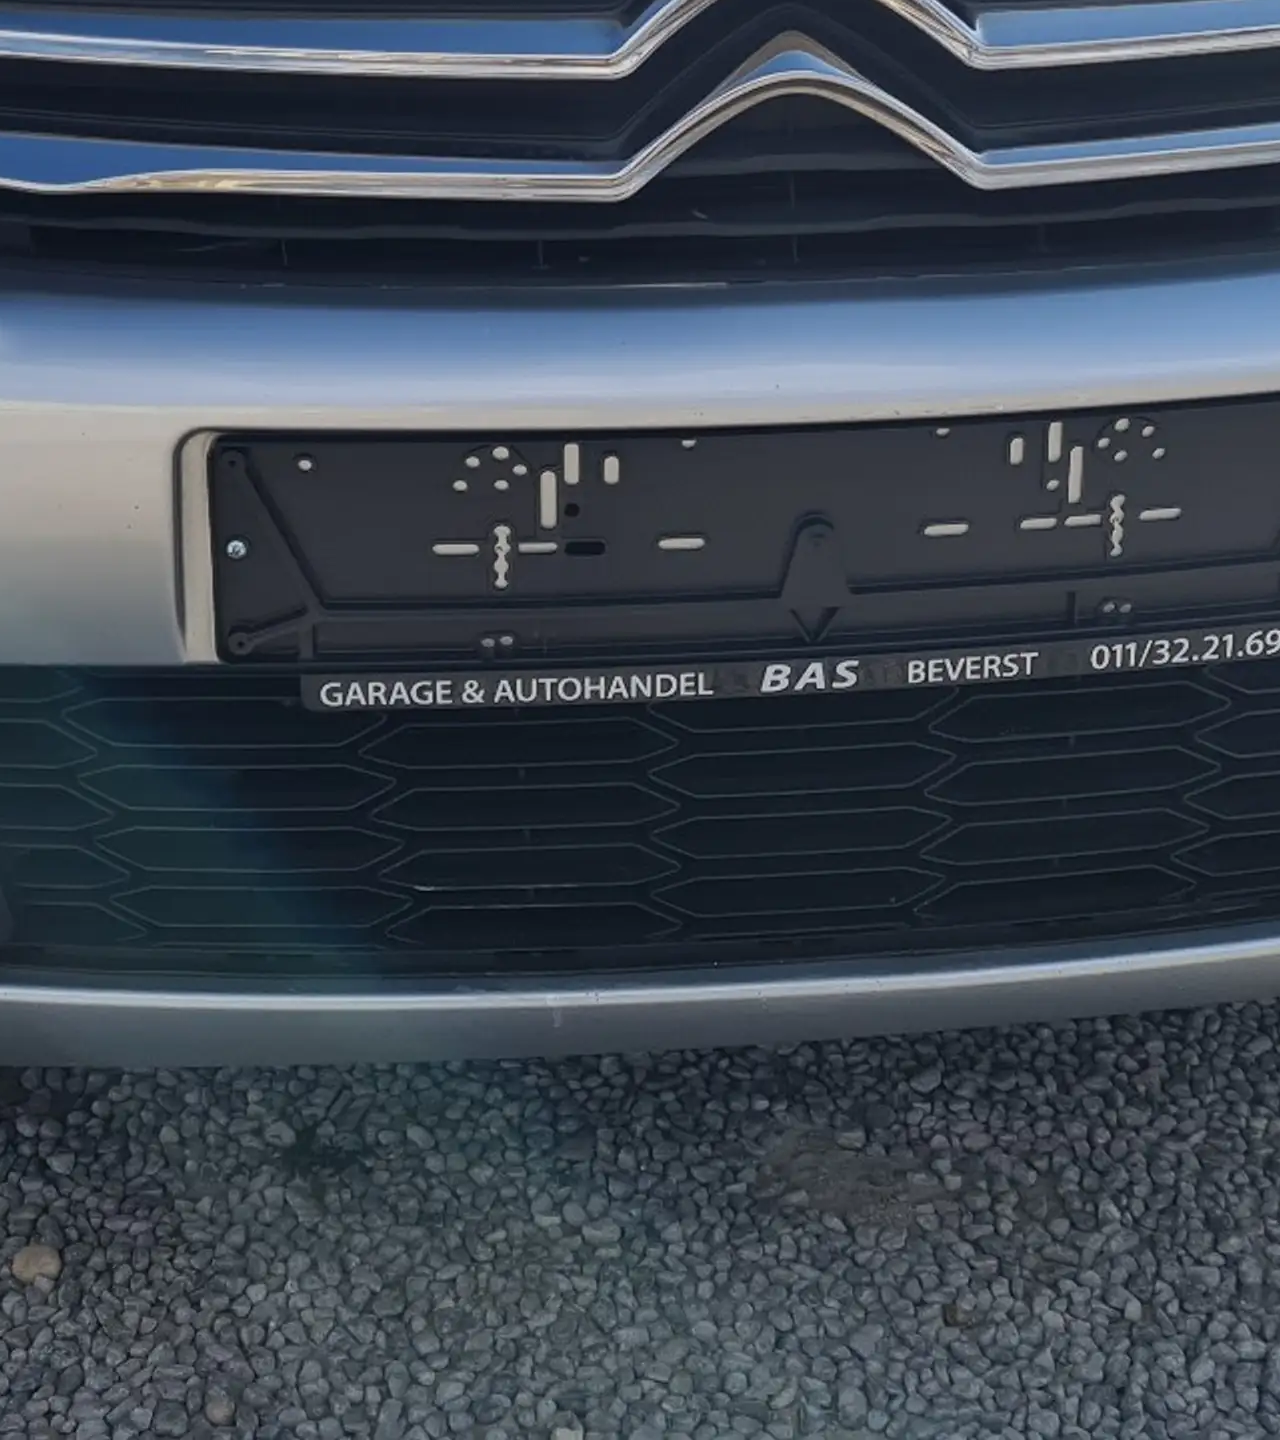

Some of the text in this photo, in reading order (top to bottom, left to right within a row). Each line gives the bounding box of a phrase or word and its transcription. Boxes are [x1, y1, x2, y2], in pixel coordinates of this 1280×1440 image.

[319, 679, 453, 707] GARAGE
[462, 678, 486, 704] &
[493, 672, 714, 704] AUTOHANDEL
[760, 660, 860, 693] BAS
[907, 651, 1039, 684] BEVERST
